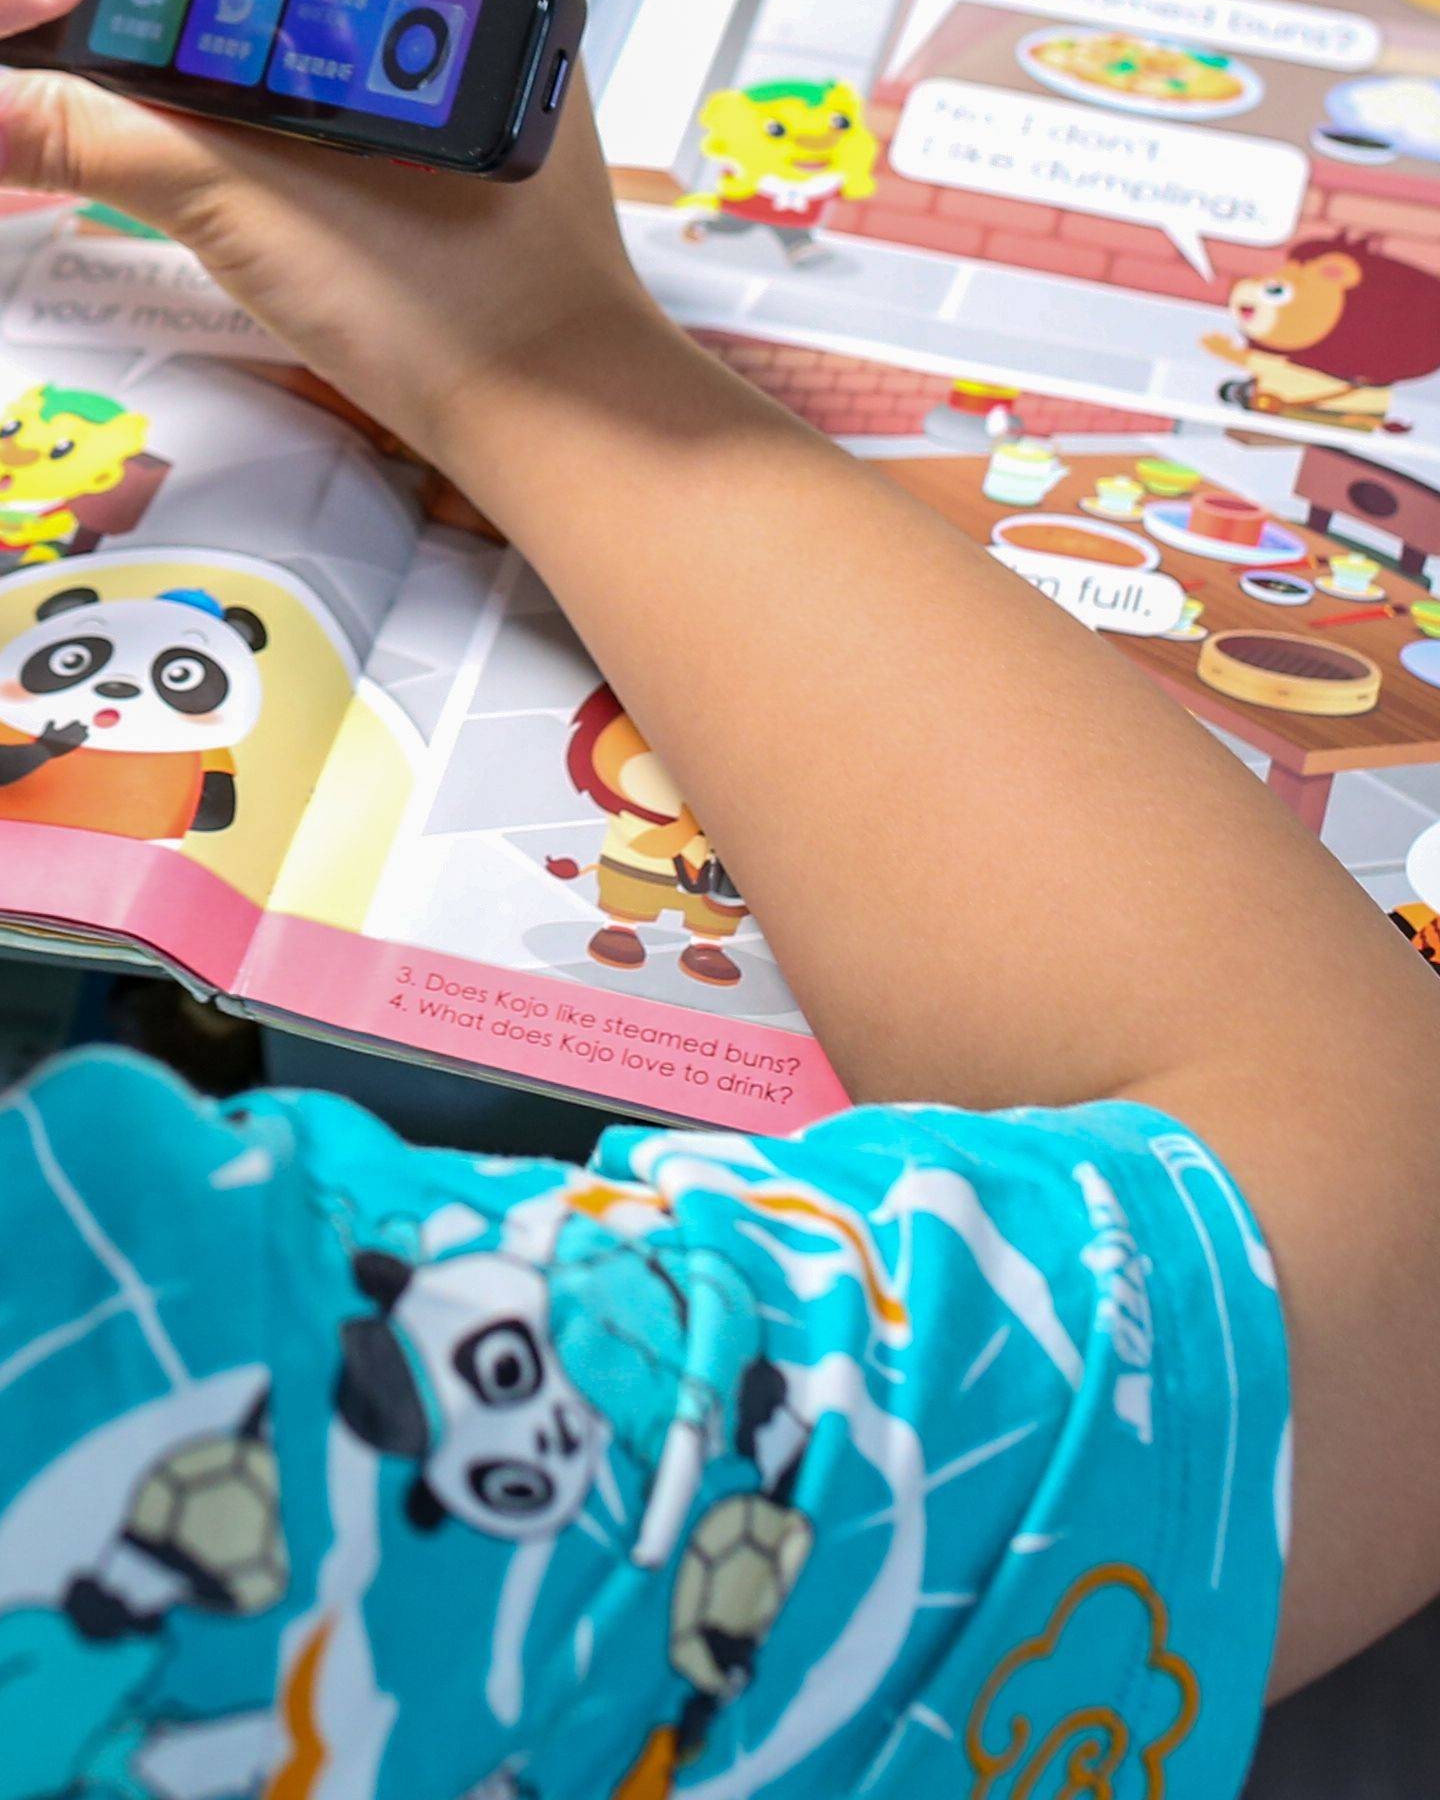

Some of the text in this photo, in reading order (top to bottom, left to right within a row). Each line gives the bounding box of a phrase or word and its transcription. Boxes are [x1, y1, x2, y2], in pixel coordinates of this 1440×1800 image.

[30, 299, 122, 328] your
[1078, 575, 1152, 617] full.
[387, 991, 794, 1106] 4. What does Kojo love to drink?
[394, 966, 801, 1076] 3. Does Kojo like steamed buns?
